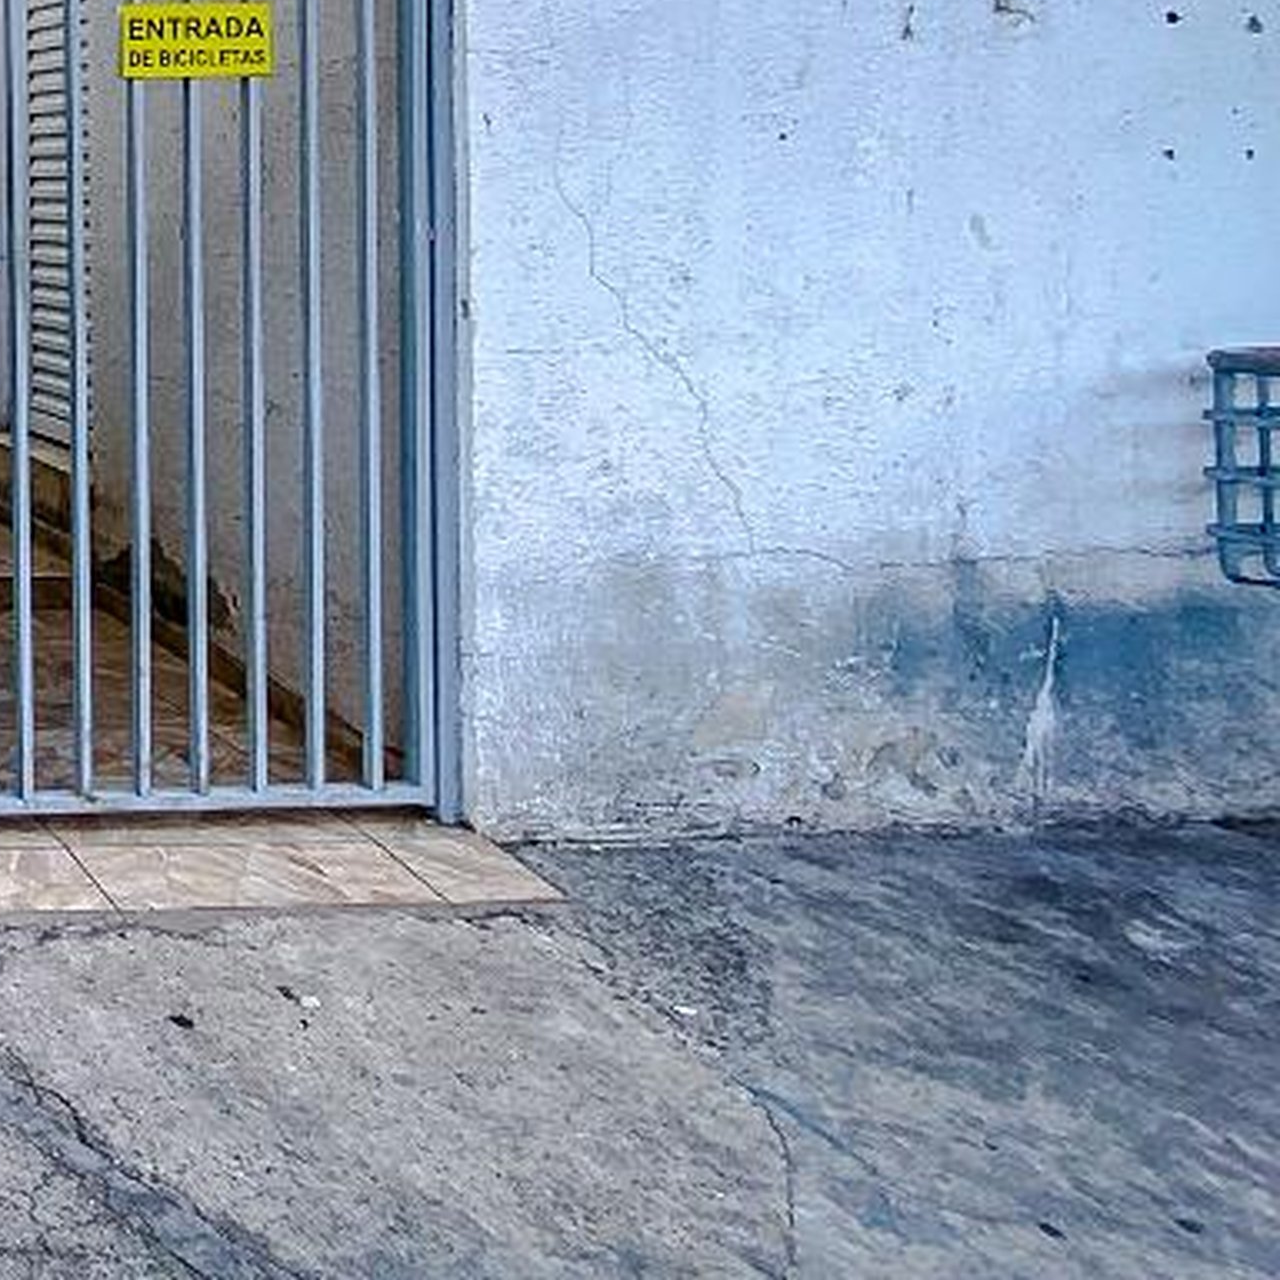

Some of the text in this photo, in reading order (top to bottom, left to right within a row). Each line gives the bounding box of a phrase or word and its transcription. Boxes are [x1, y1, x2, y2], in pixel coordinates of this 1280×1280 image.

[128, 16, 265, 41] ENTRADA
[128, 49, 267, 68] DE BICICLETAS
